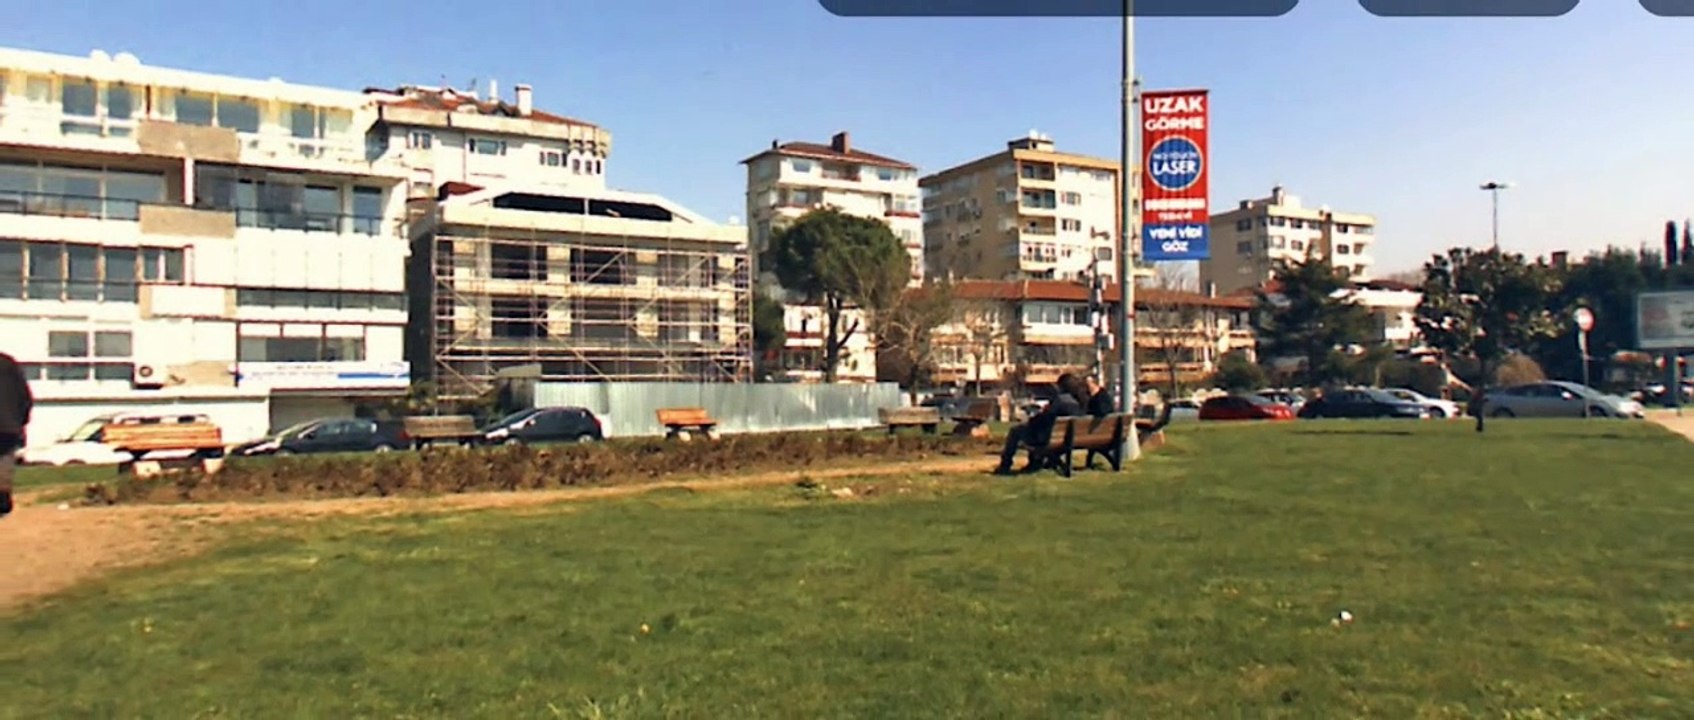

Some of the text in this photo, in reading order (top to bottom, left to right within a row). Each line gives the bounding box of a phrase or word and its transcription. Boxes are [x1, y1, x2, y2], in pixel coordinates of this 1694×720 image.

[1144, 96, 1204, 114] UZAK
[1144, 116, 1205, 132] GÖRME
[1152, 160, 1197, 176] LASER
[1161, 240, 1189, 253] GÖZ
